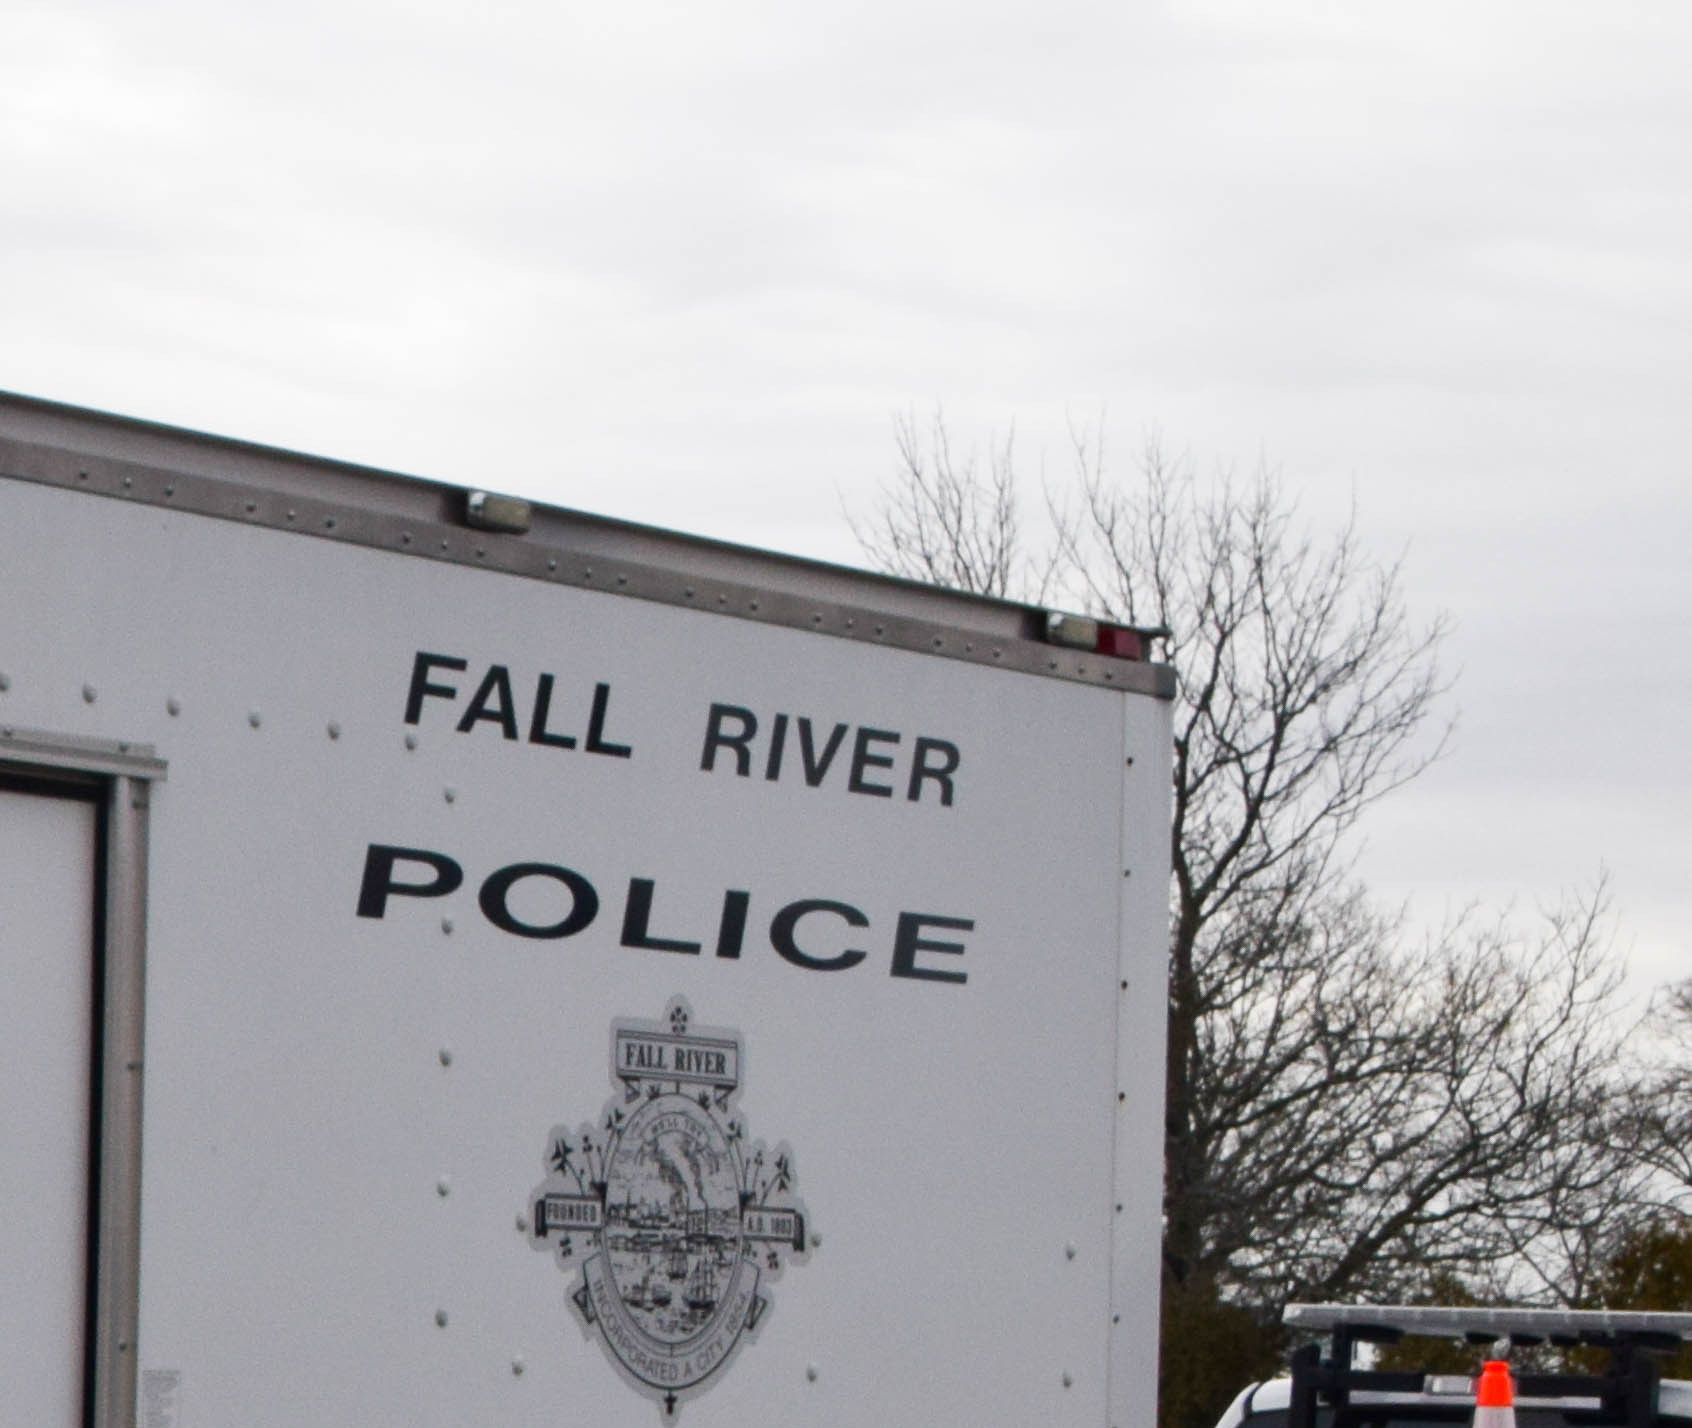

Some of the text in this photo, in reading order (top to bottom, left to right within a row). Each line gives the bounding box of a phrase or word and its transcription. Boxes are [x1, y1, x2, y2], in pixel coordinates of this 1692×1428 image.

[404, 650, 962, 807] FALL RIVER
[354, 843, 977, 985] POLICE
[625, 1042, 727, 1075] FALL RIVER
